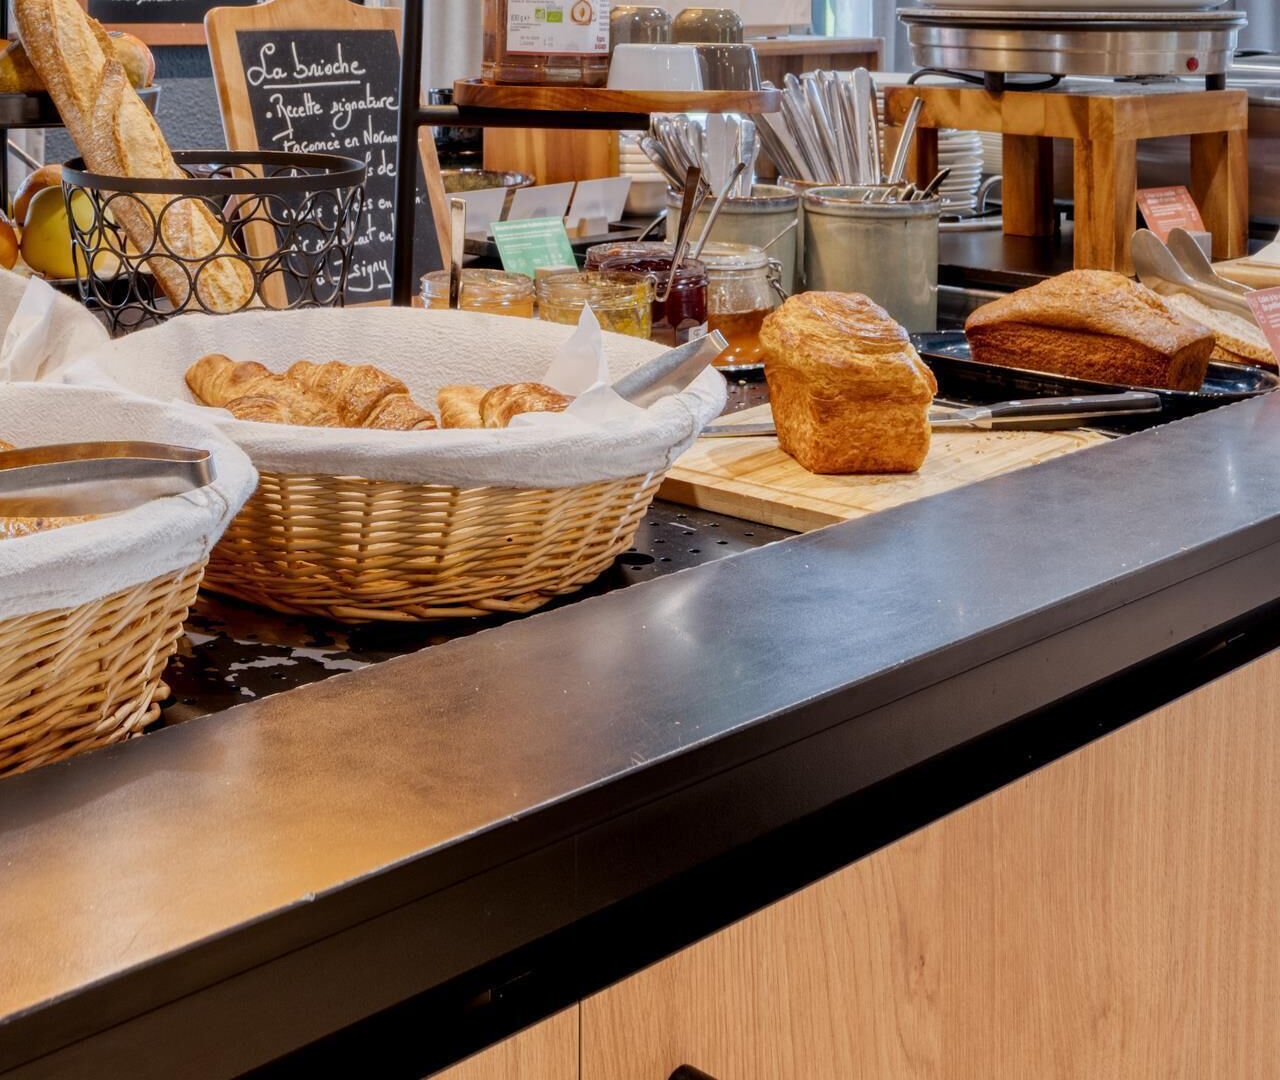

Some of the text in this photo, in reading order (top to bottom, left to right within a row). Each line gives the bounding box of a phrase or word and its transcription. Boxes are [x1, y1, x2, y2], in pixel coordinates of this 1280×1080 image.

[247, 41, 366, 86] La brioche
[270, 82, 400, 132] Recette signature
[344, 134, 360, 148] en
